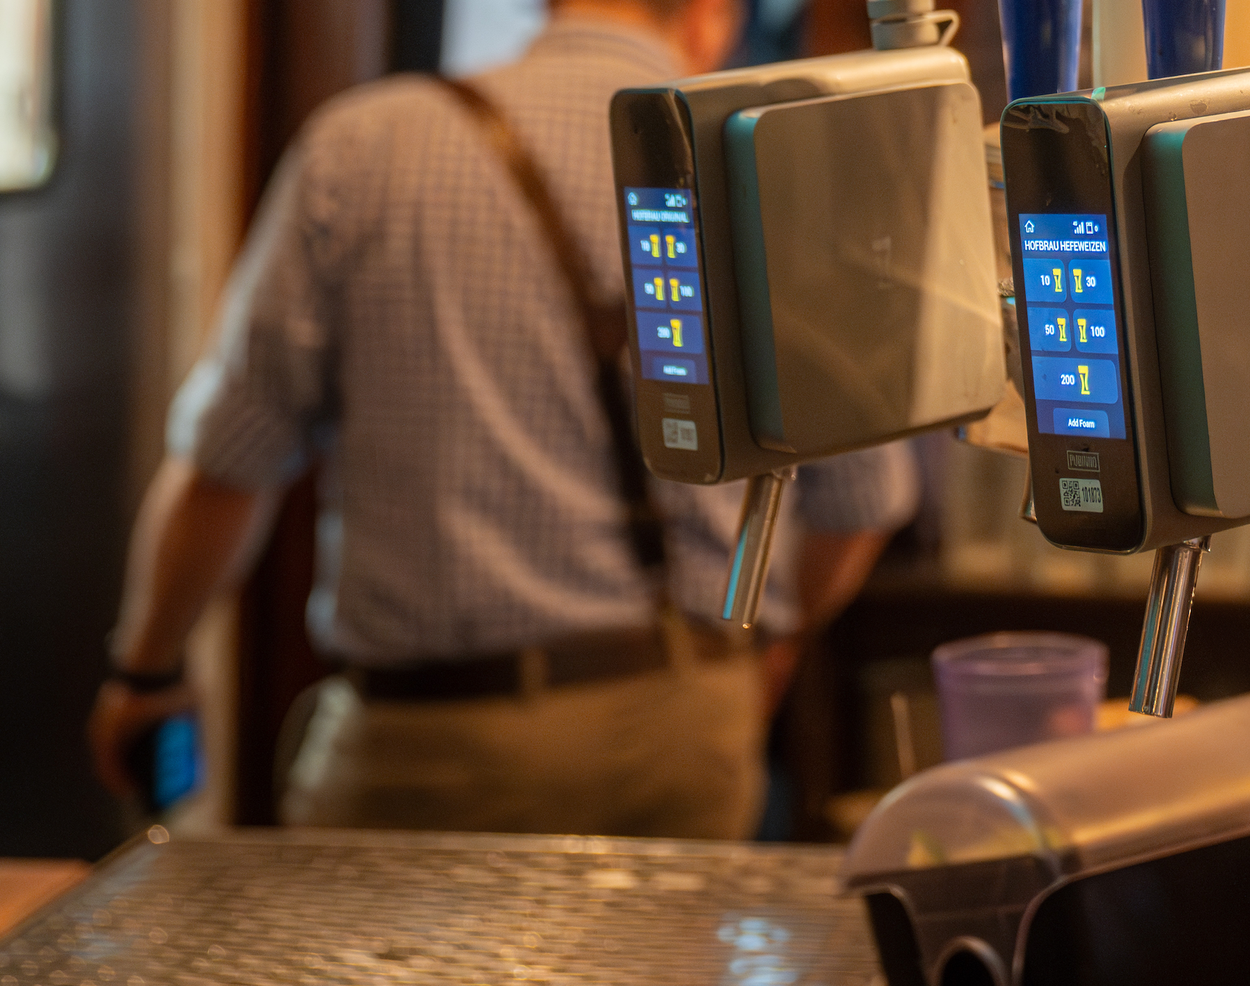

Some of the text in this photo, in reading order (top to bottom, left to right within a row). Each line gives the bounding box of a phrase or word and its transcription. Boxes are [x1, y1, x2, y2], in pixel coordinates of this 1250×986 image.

[1024, 240, 1107, 252] HOFBRAU HEFEWEIZEN
[1040, 274, 1051, 286] 10
[1086, 275, 1097, 288] 30
[1044, 324, 1056, 335] 50
[1090, 325, 1105, 338] 100
[1060, 373, 1076, 386] 200
[1067, 418, 1096, 429] Add Foam
